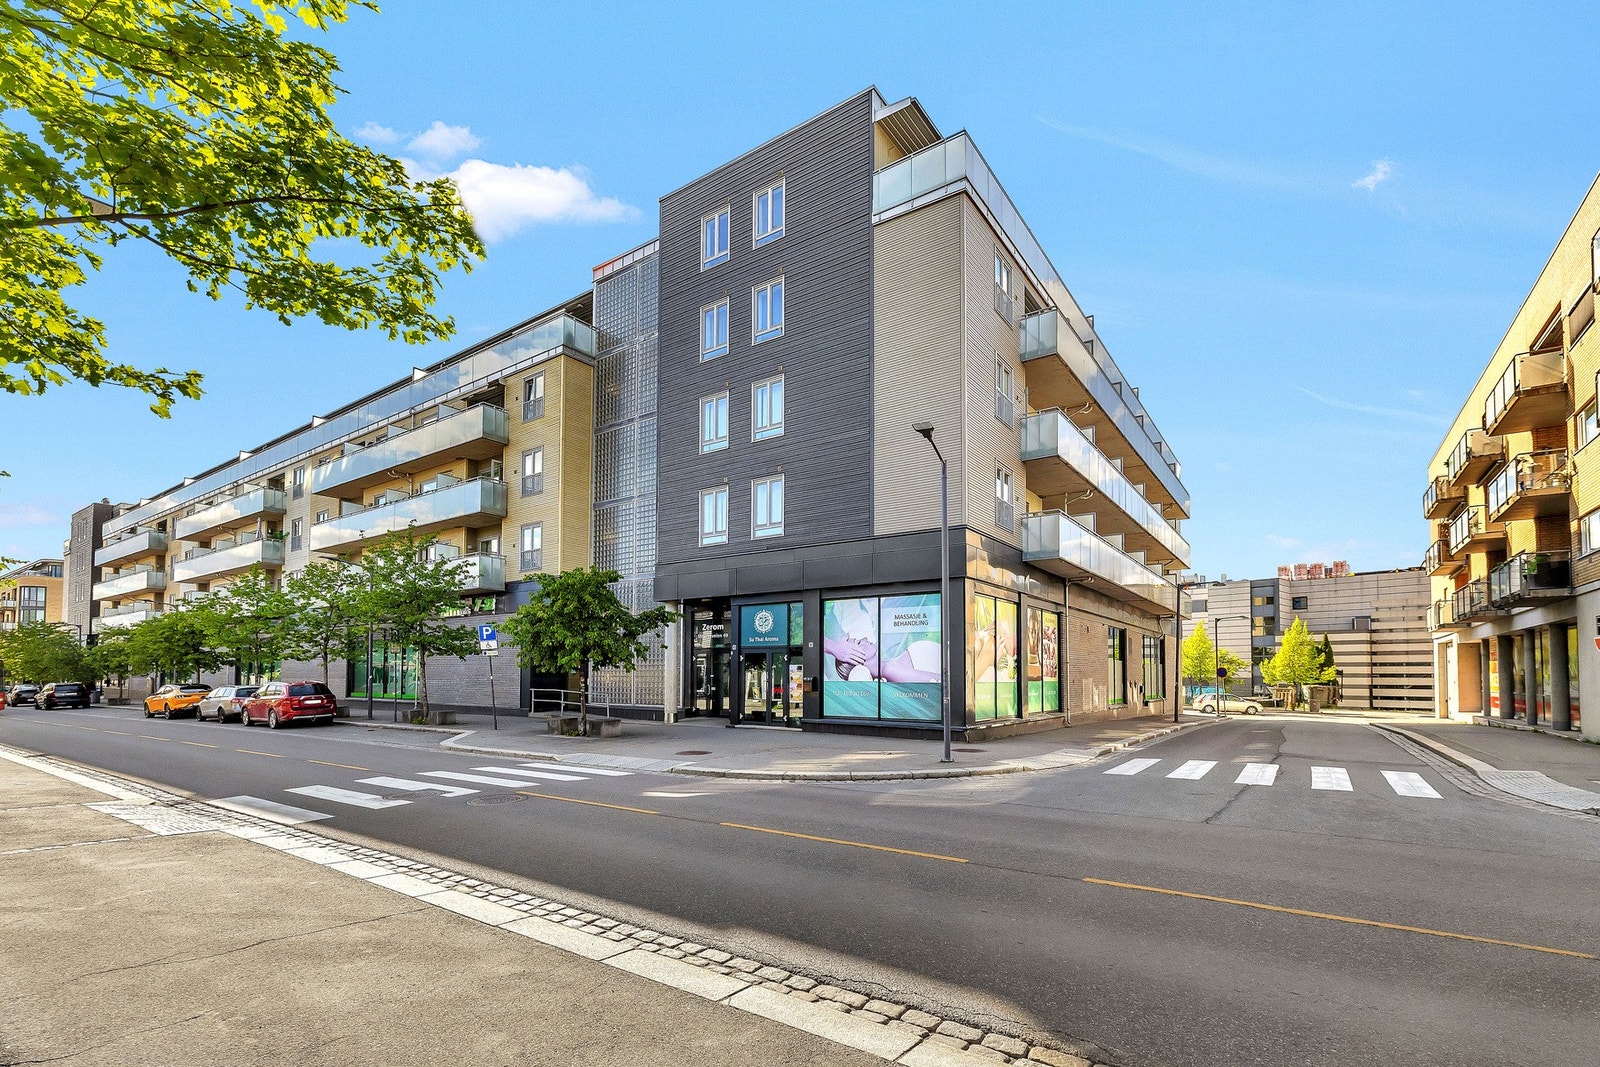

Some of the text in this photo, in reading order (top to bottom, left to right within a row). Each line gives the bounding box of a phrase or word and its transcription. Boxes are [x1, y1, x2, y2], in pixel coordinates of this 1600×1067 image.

[702, 623, 724, 631] Zerom
[482, 626, 492, 639] P
[892, 691, 929, 699] VELKOMMEN
